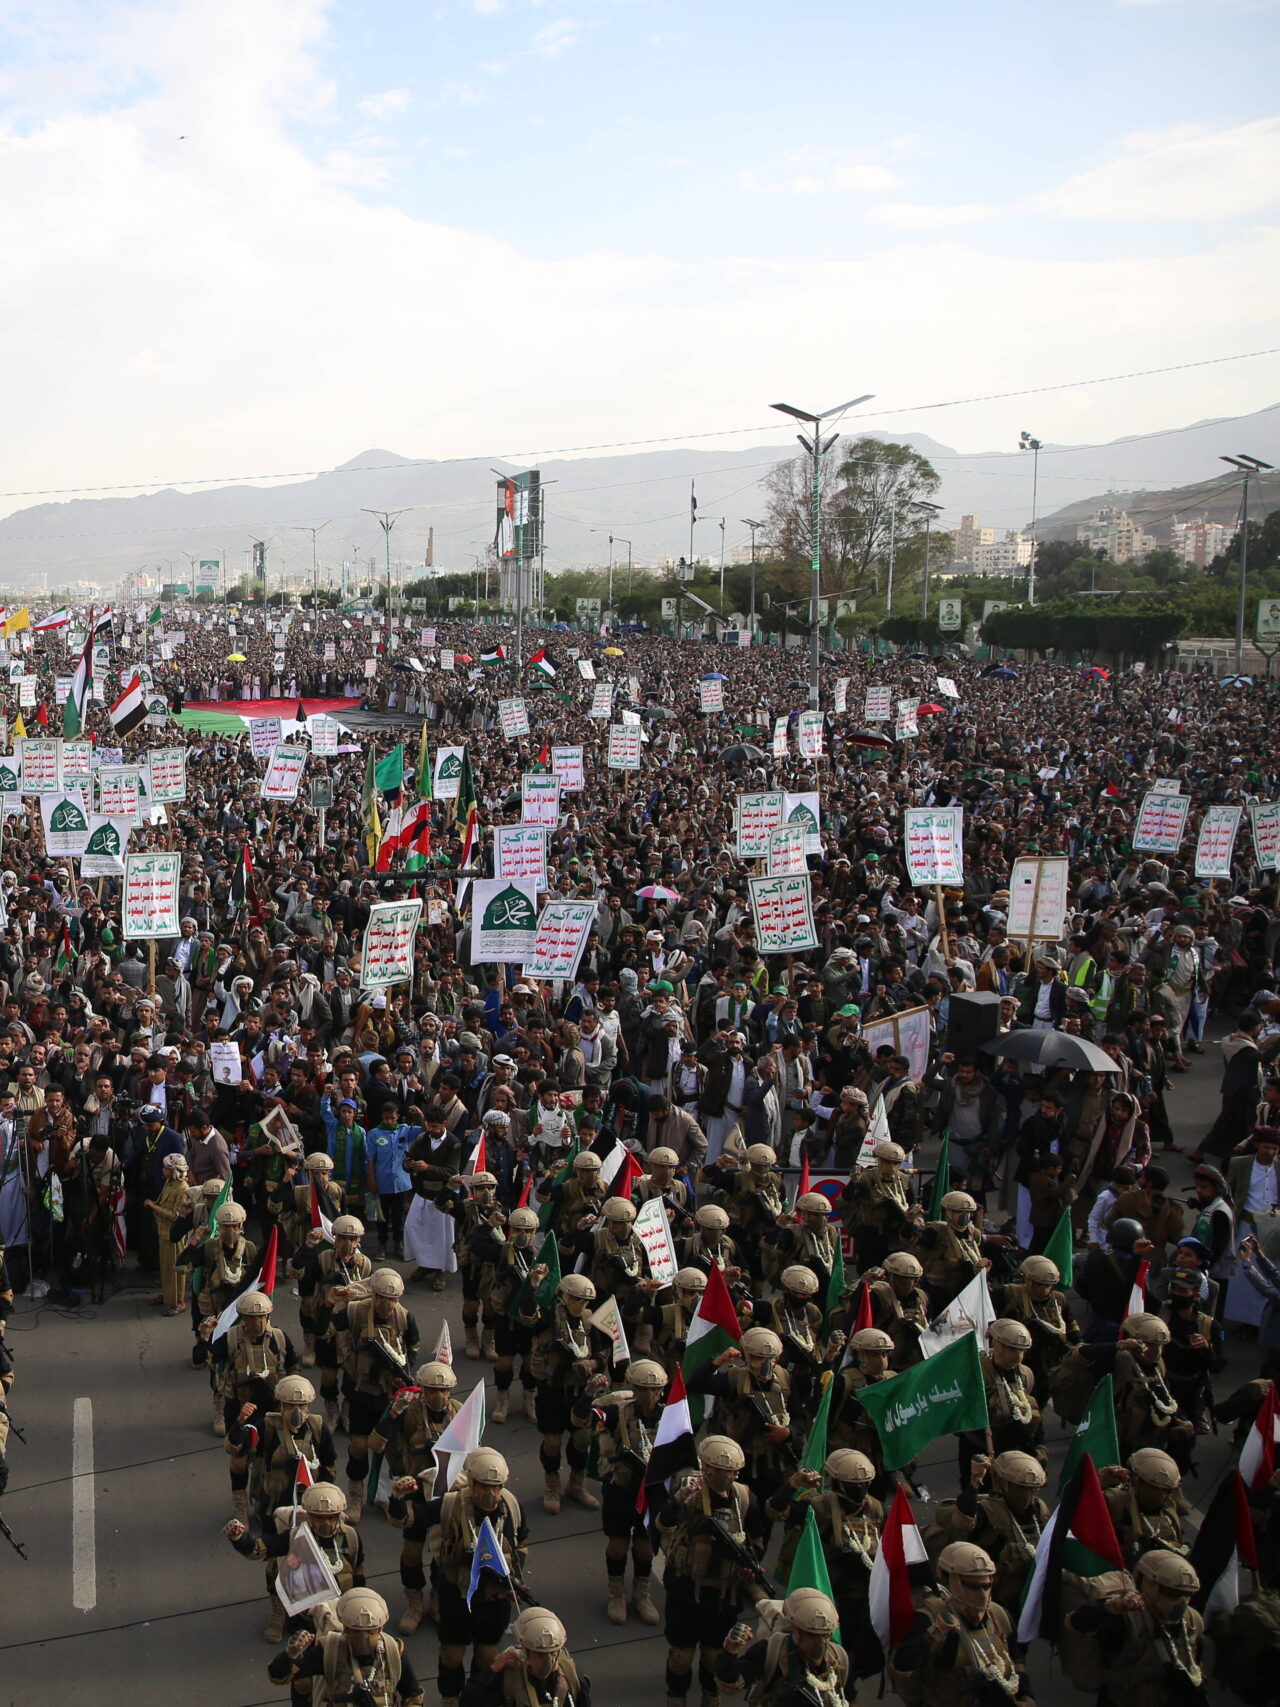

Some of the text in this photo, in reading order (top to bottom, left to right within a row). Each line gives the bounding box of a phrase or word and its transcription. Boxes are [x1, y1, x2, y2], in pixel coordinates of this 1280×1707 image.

[159, 859, 175, 871] الله
[156, 877, 174, 887] الموت
[787, 880, 805, 890] الله
[155, 891, 174, 900] الموت
[785, 893, 806, 904] الموت
[127, 904, 173, 916] اللعنة على اليهود
[787, 906, 807, 917] الموت
[155, 917, 174, 932] النصر
[761, 917, 808, 932] اللعنة على اليهود
[790, 929, 811, 944] النصر
[929, 1379, 963, 1404] لبيك
